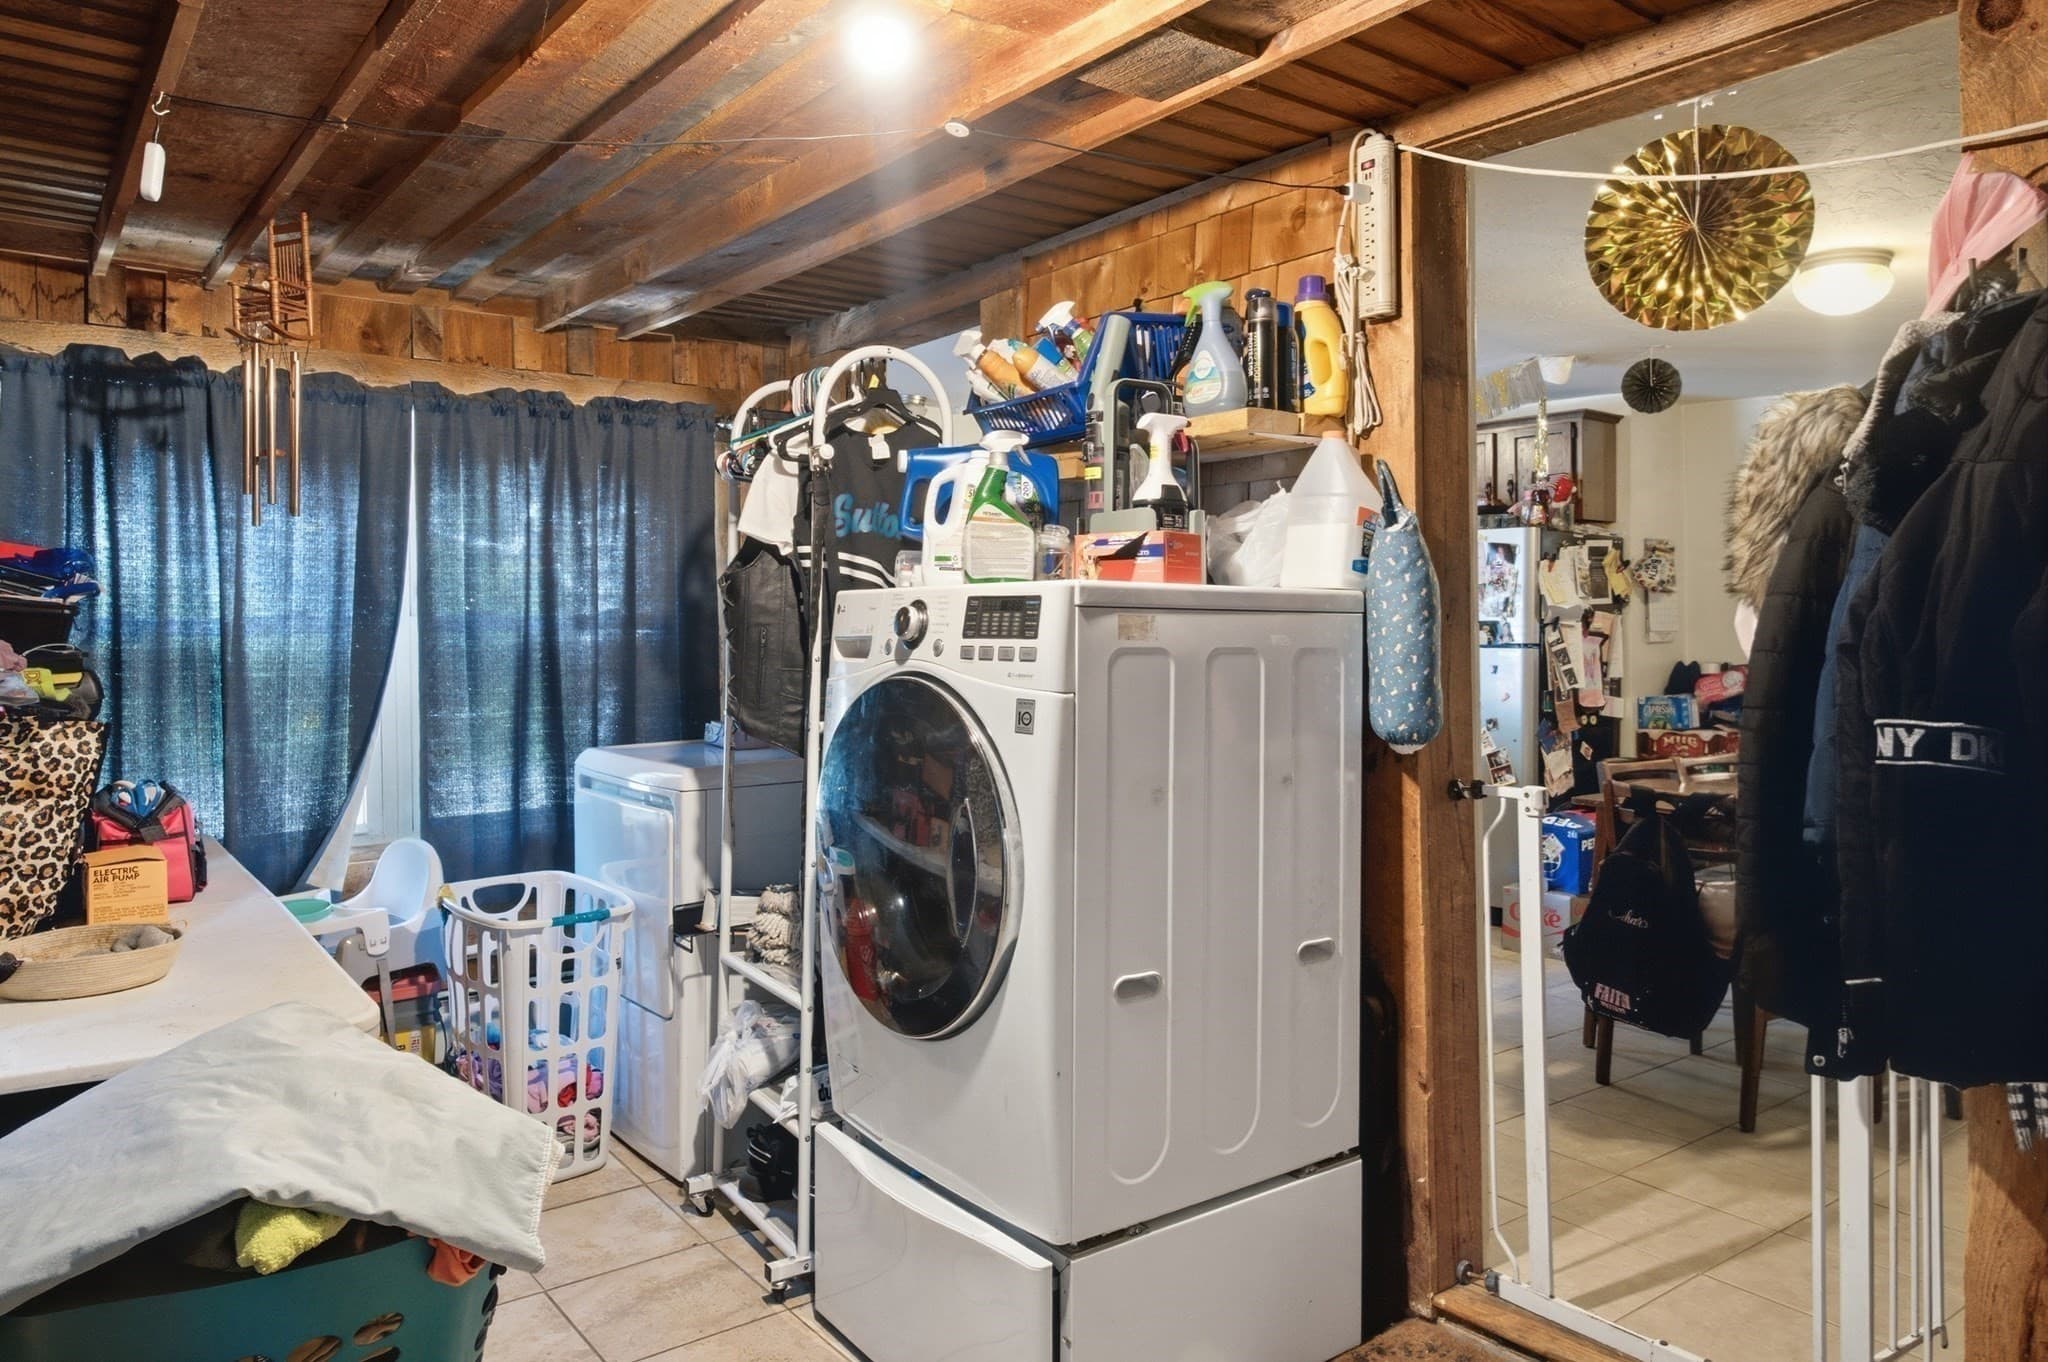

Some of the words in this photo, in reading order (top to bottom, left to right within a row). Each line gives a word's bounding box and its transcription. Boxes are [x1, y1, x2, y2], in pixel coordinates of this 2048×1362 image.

[1876, 726, 1926, 758] NY
[93, 865, 139, 877] ELECTRIC
[92, 875, 109, 884] AIR
[111, 872, 141, 882] PUMP
